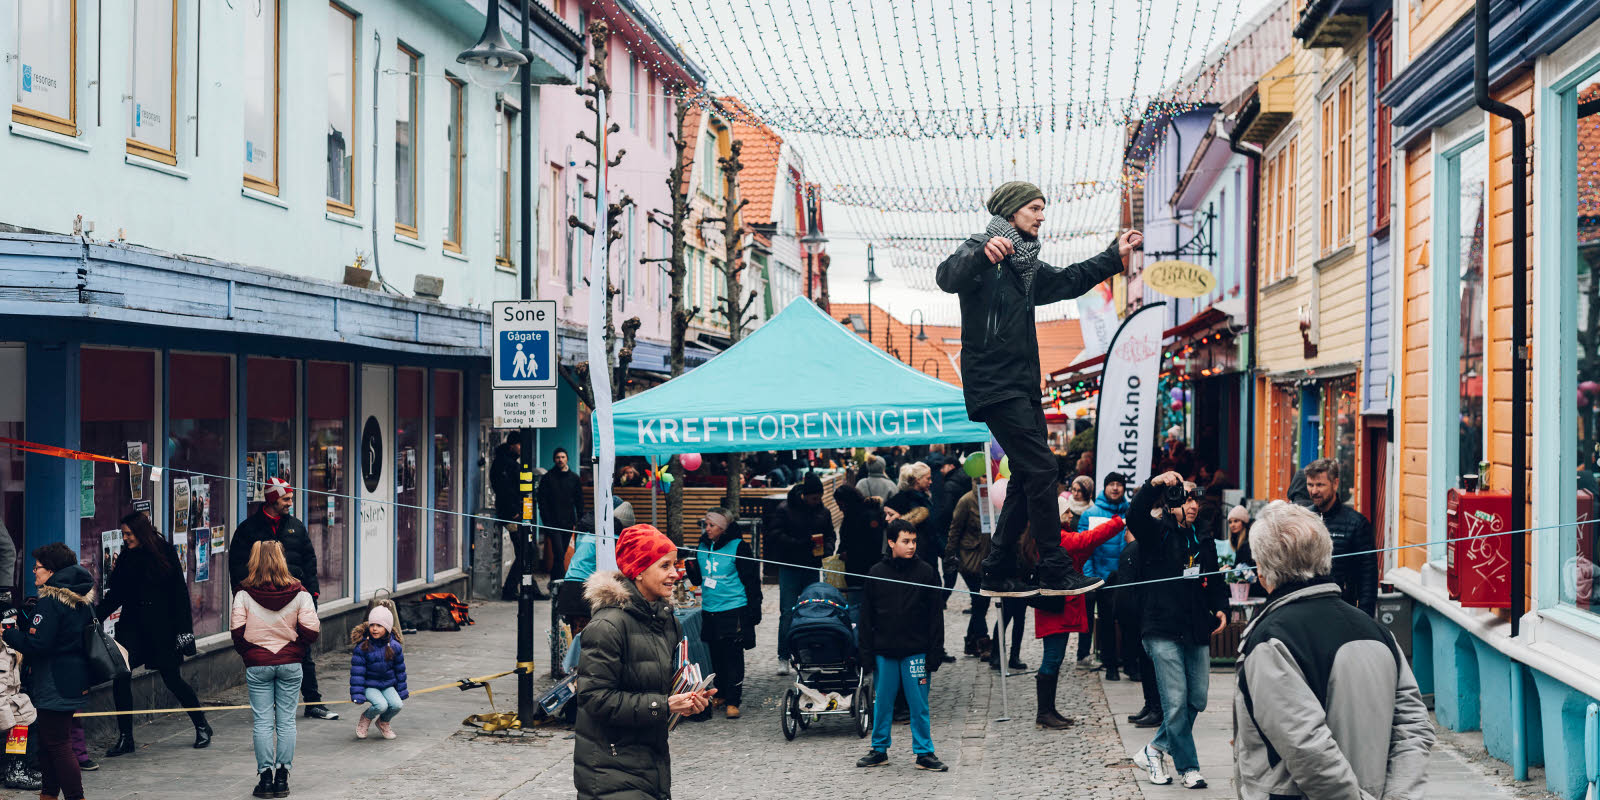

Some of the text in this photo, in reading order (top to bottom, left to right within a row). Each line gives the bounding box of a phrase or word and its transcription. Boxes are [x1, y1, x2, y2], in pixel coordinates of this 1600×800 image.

[1151, 265, 1208, 291] CIRKUS
[503, 306, 546, 322] Sone
[507, 331, 542, 343] Gågate
[637, 407, 943, 444] KREFTFORENINGEN
